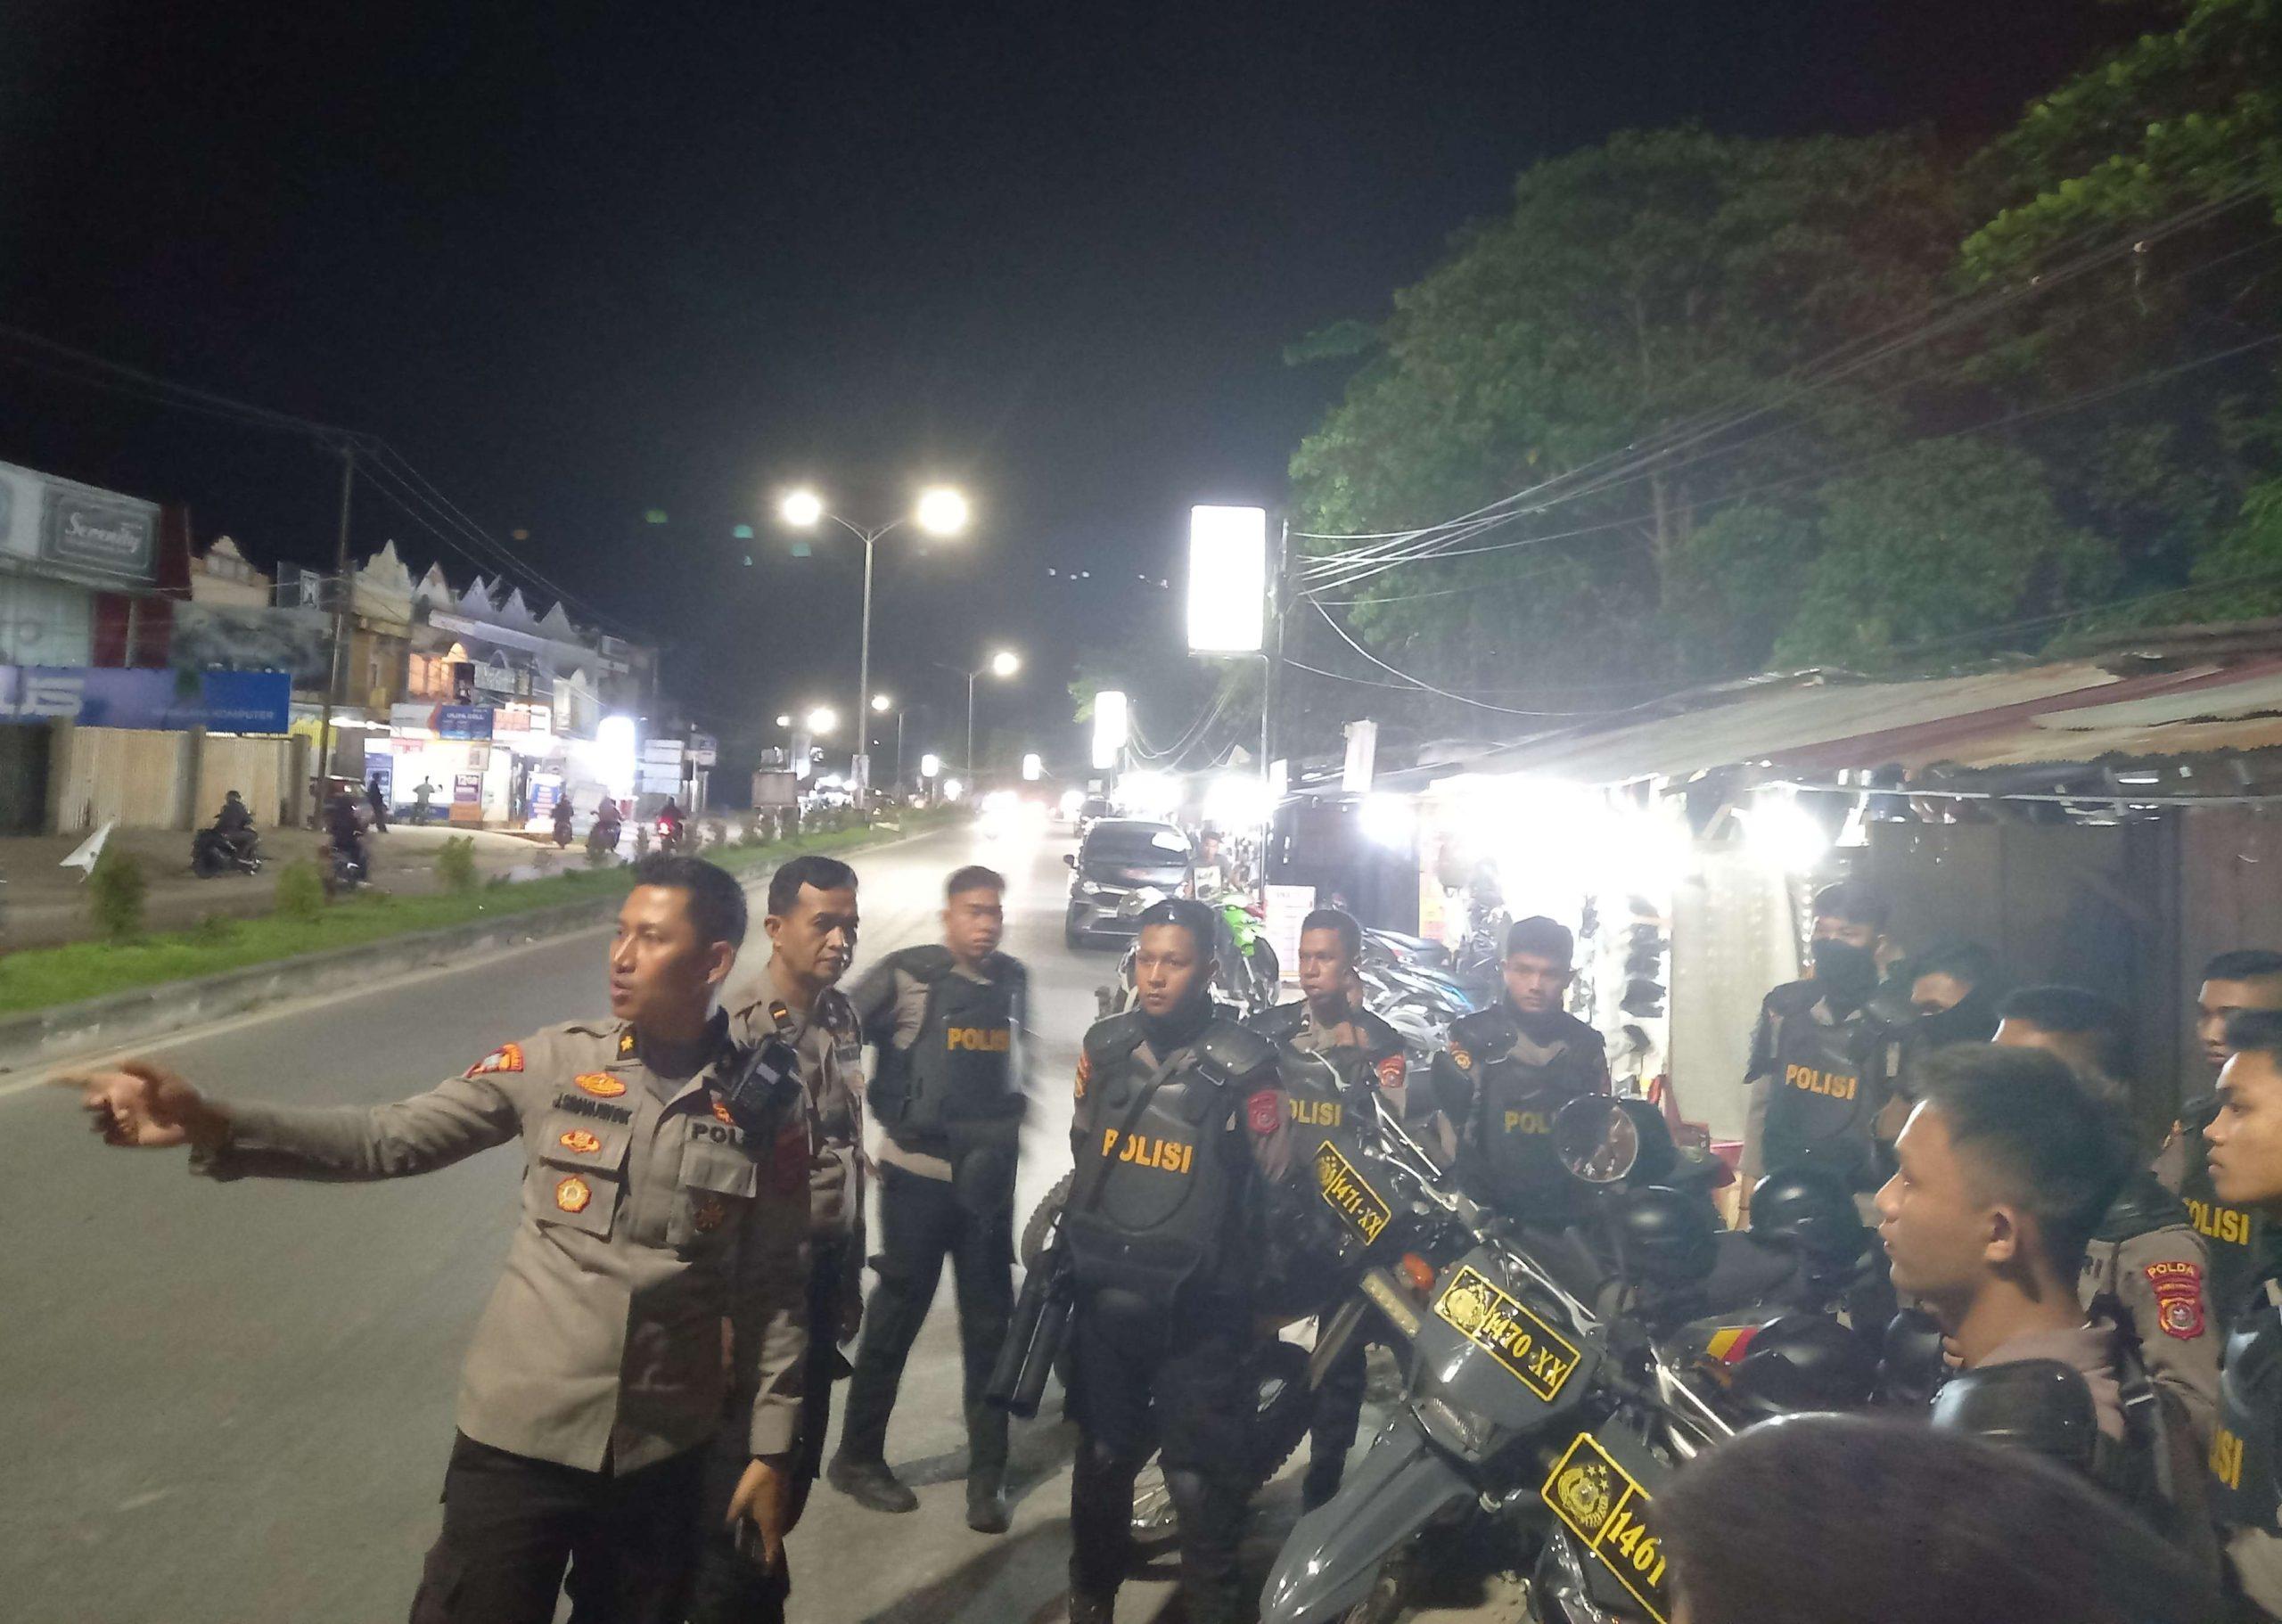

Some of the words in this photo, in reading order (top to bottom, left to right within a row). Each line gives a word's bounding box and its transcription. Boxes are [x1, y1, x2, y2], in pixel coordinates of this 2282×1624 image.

[948, 1028, 1010, 1051] POLIS
[1785, 1064, 1855, 1100] POLISI
[692, 1122, 743, 1144] POL
[1505, 1111, 1554, 1134] POL
[1102, 1128, 1193, 1174] POLISI
[2182, 1198, 2250, 1245] OLISI
[2147, 1262, 2196, 1280] POLDA
